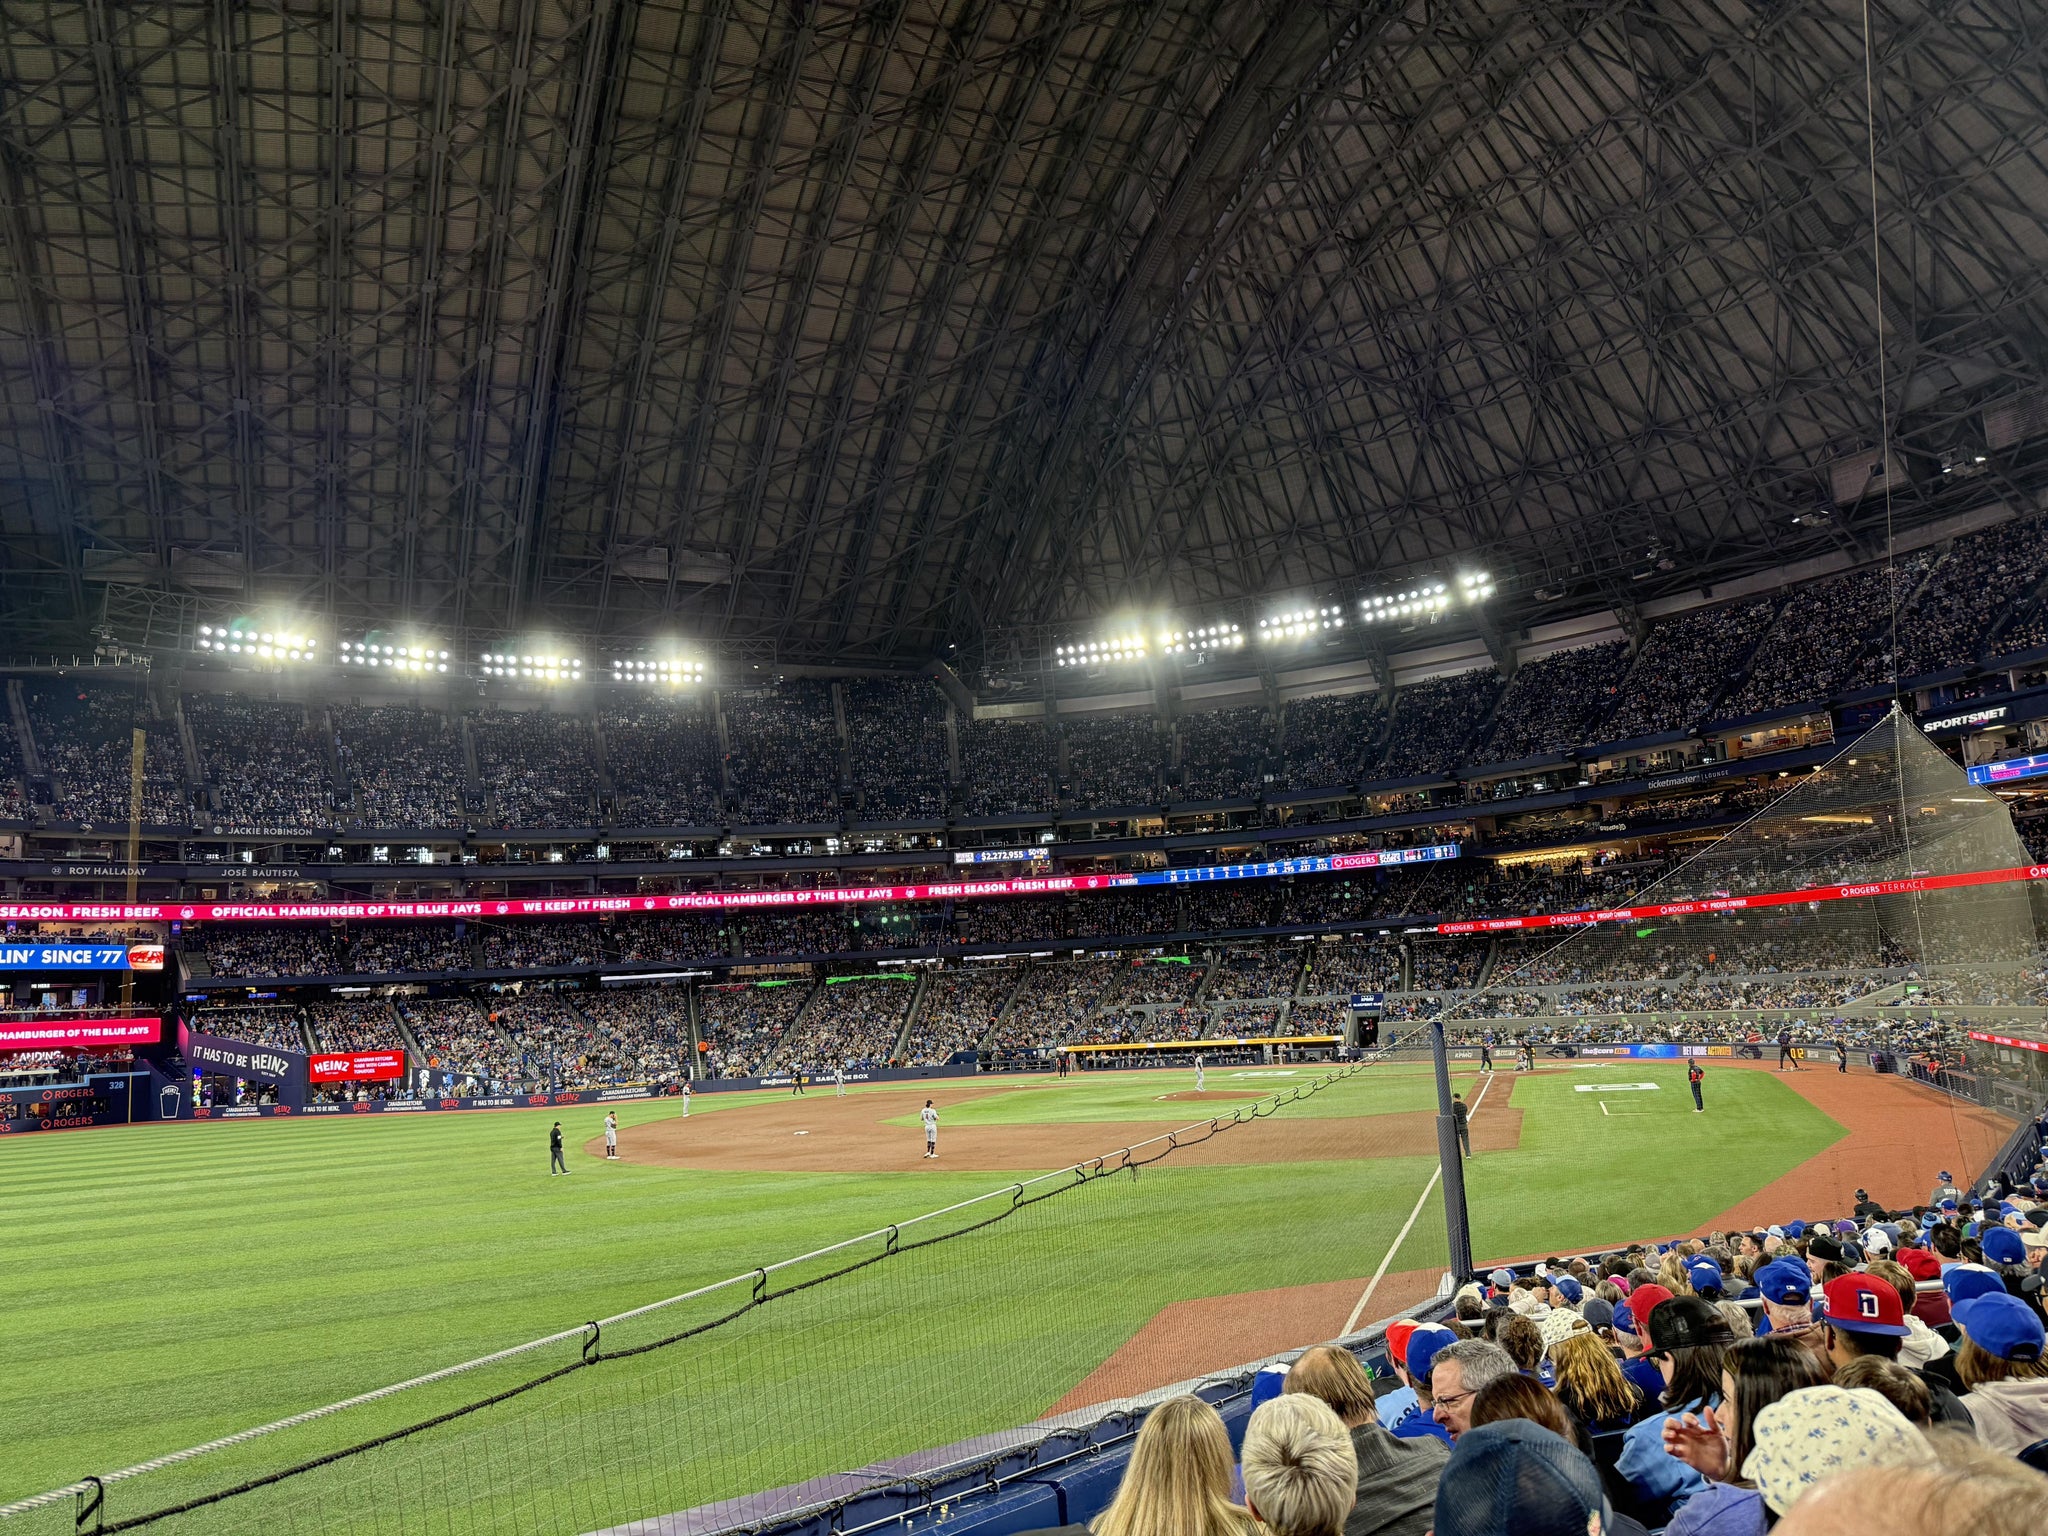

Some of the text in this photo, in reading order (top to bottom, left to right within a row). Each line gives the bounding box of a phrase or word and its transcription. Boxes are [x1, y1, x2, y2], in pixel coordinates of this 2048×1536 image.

[1924, 707, 2006, 732] SPORTSNET
[1648, 770, 1729, 789] ticketmaster LOUNGE
[264, 828, 312, 836] ROBINSON
[1344, 856, 1375, 866] ROGERS
[69, 867, 91, 875] ROY
[94, 868, 147, 876] HALLADAY
[222, 868, 299, 877] JOSÉ BAUTISTA
[928, 879, 1076, 895] FRESH SEASON. FRESH BEEF.
[1849, 880, 1925, 896] ROGERS TERRACE
[669, 889, 893, 907] OFFICIAL HAMBURGER OF THE BLUE JAYS
[212, 903, 482, 917] OFFICIAL HAMBURGER OF THE BLUE JAYS
[523, 899, 631, 911] WE KEEP IT FRESH
[1668, 899, 1748, 913] ROGERS PROUD OWNER
[0, 906, 163, 917] SEASON. FRESH BEEF.
[1556, 914, 1582, 923] ROGERS
[1451, 923, 1475, 931] ROGERS
[42, 949, 92, 964] SINCE
[96, 949, 122, 964] '77
[0, 1026, 150, 1040] HAMBURGER OF THE BLUE JAYS
[1582, 1048, 1614, 1056] theScore
[193, 1045, 203, 1059] IT
[203, 1047, 221, 1063] HAS
[222, 1051, 235, 1065] TO
[236, 1054, 248, 1068] BE
[251, 1054, 289, 1077] HEINZ
[314, 1060, 350, 1074] HEINZ
[109, 1081, 124, 1090] 328
[54, 1088, 95, 1099] ROGERS
[555, 1092, 580, 1103] HEINZ
[440, 1098, 460, 1108] HEINZ
[528, 1095, 549, 1104] HEINZ
[273, 1105, 292, 1114] HEINZ
[353, 1102, 371, 1111] HEINZ
[193, 1108, 211, 1117] HEINZ
[54, 1116, 94, 1127] ROGERS
